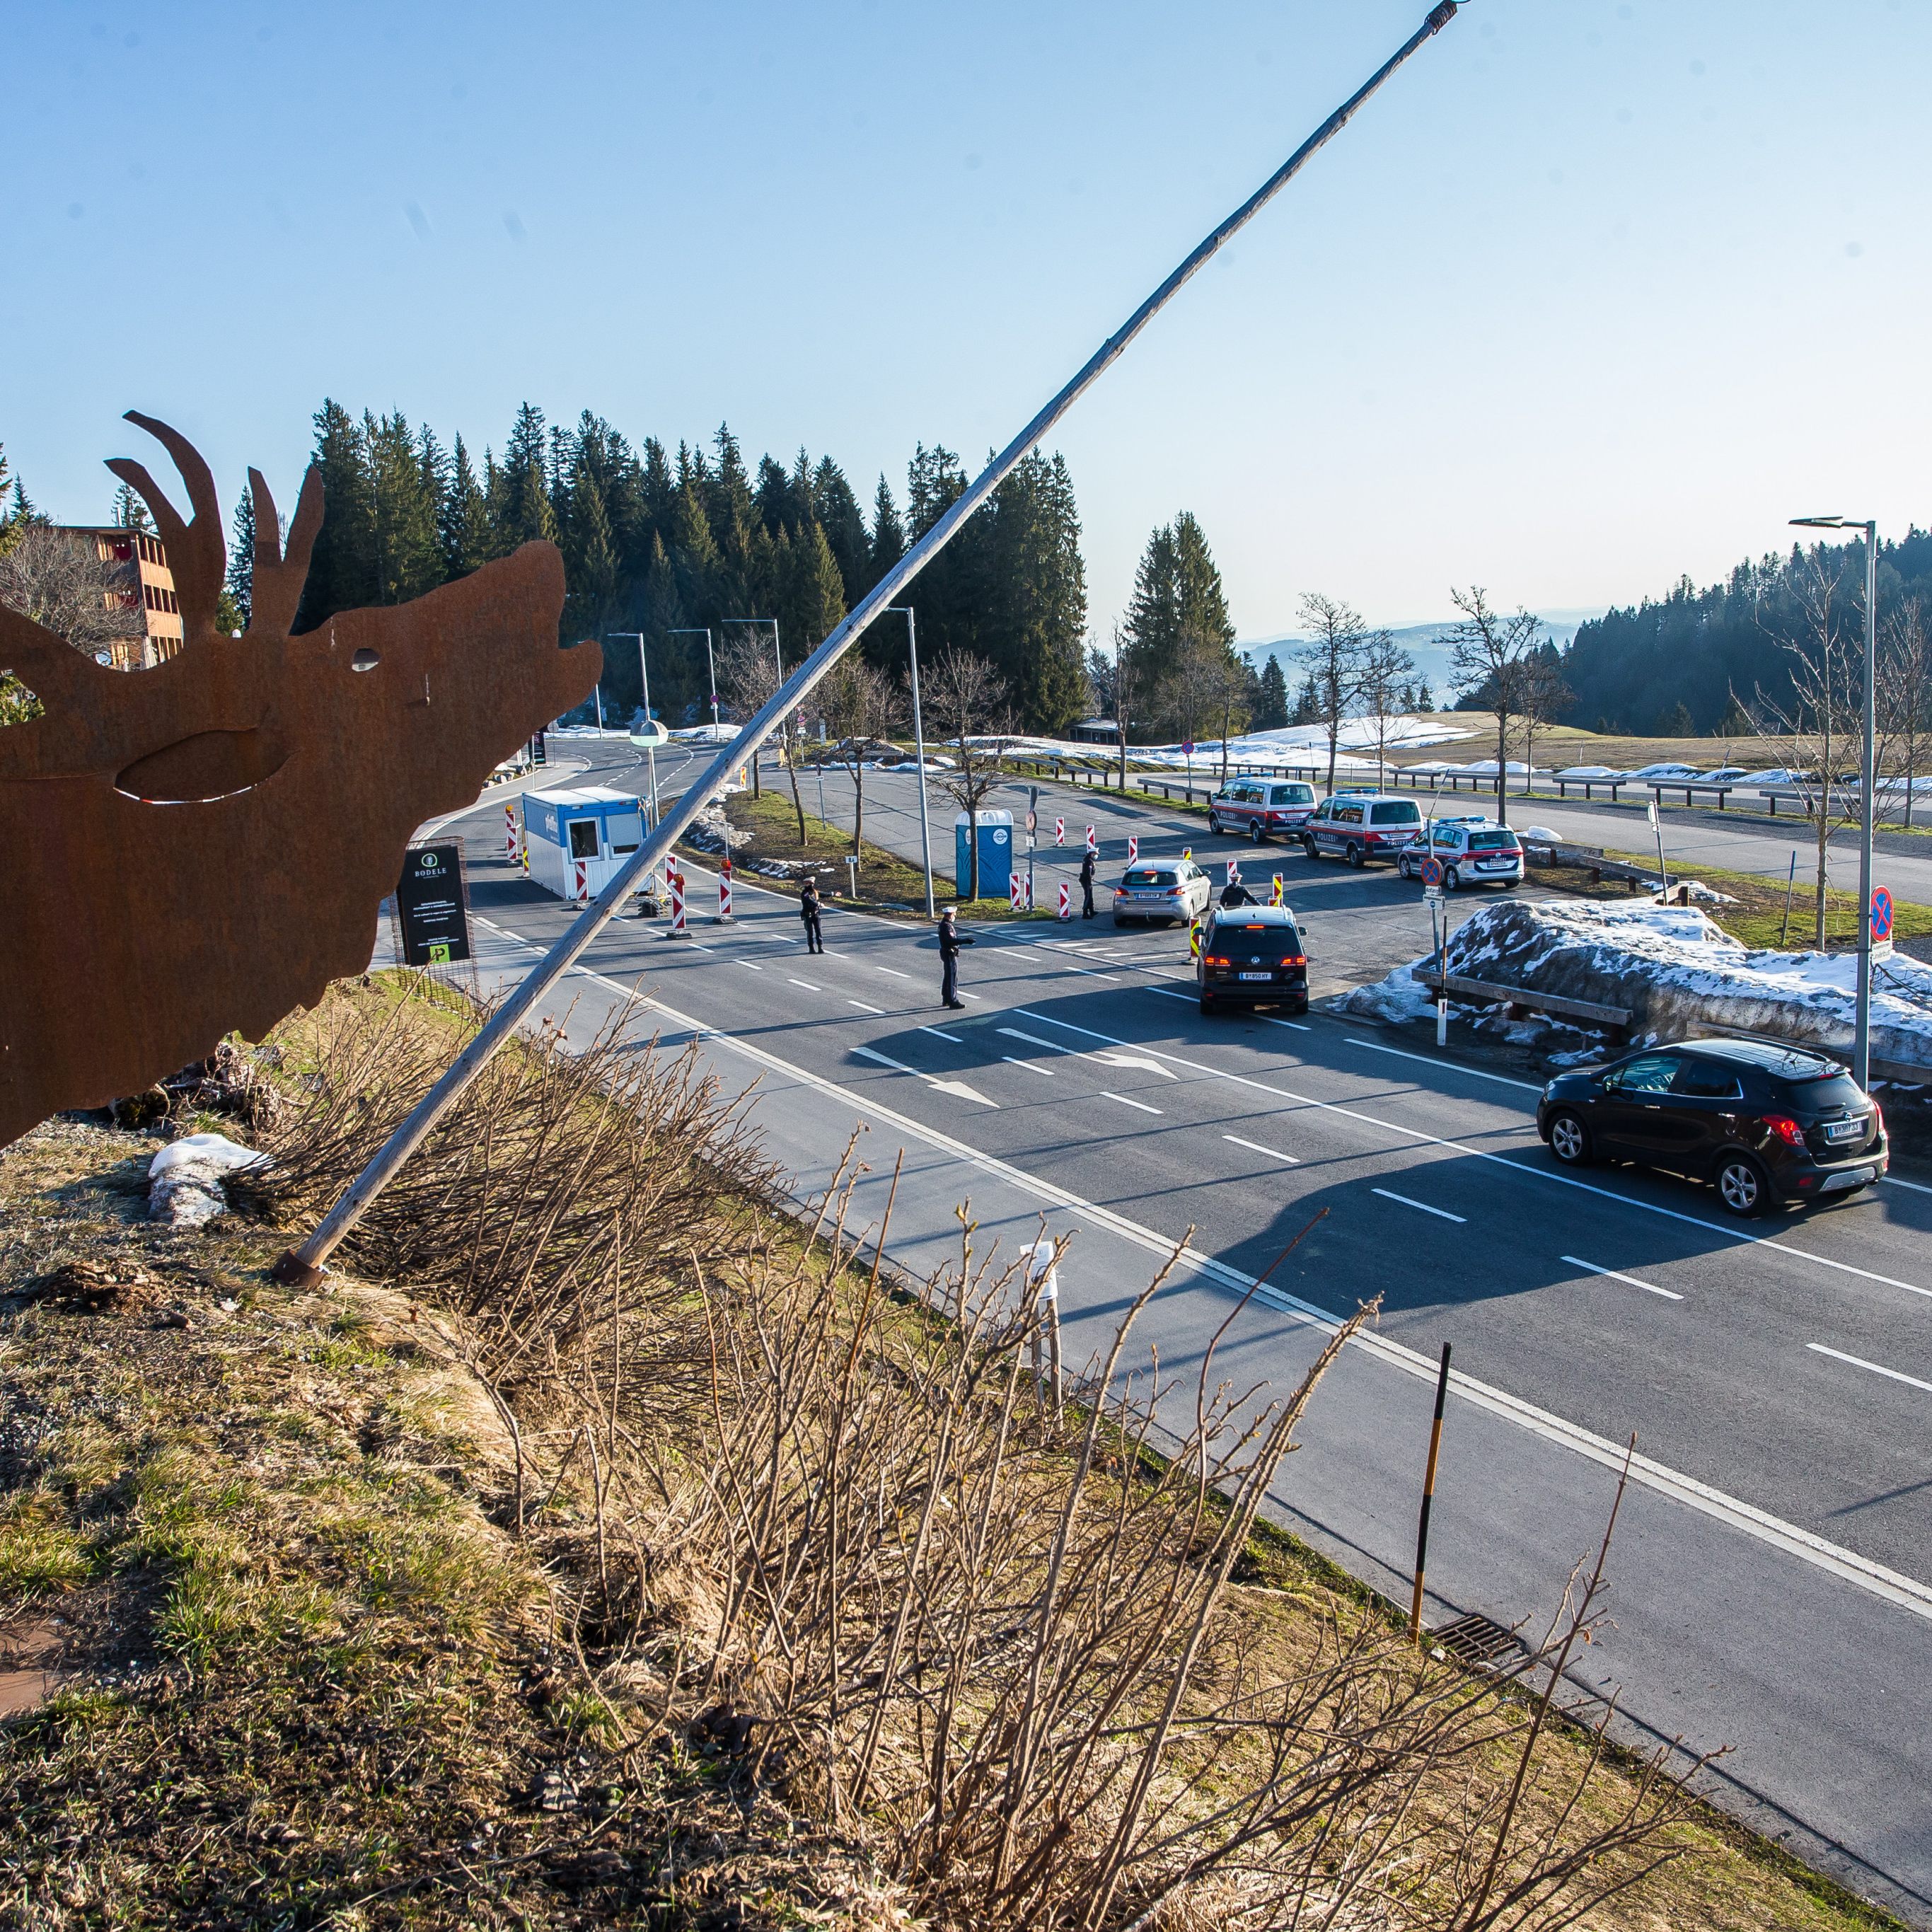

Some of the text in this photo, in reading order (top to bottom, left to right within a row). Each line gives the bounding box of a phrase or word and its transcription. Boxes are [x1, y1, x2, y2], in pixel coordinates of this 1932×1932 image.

[1220, 811, 1236, 820] POLIZEI
[1317, 833, 1336, 843] POLIZEI
[435, 948, 445, 961] P
